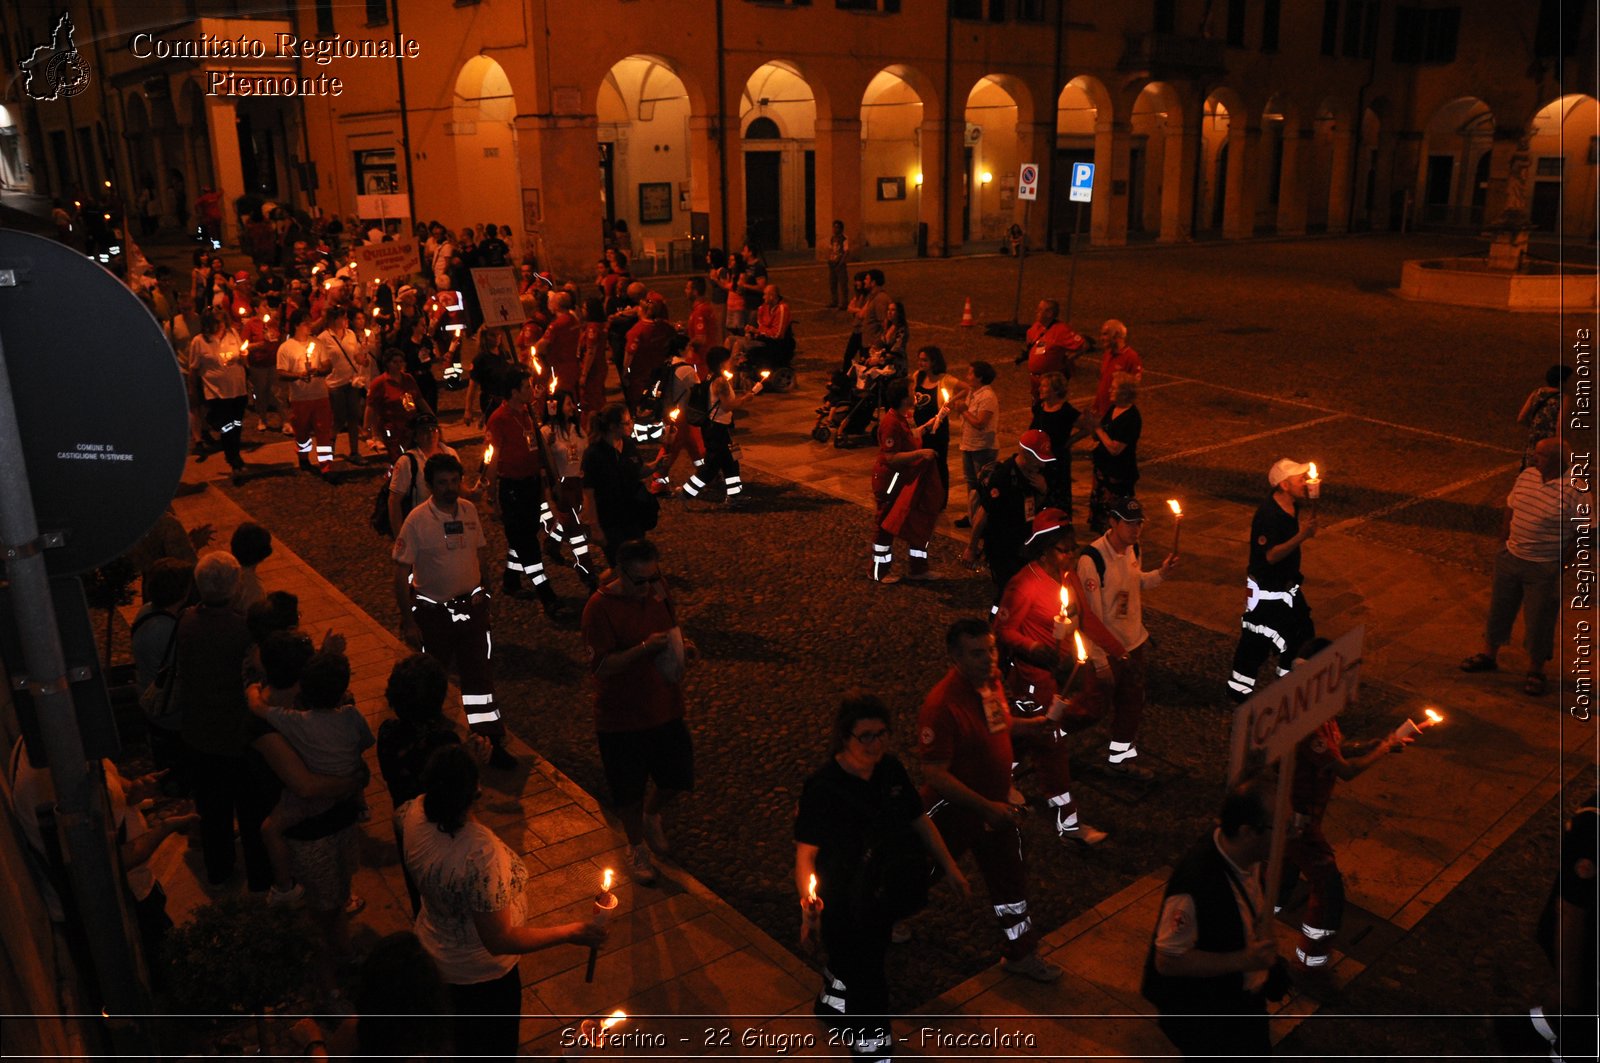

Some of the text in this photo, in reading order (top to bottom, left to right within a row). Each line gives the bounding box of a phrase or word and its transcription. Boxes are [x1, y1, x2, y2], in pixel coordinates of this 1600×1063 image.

[1075, 165, 1091, 186] P
[76, 443, 114, 452] COMUNE DI
[57, 452, 98, 460] CASTIGLIONE
